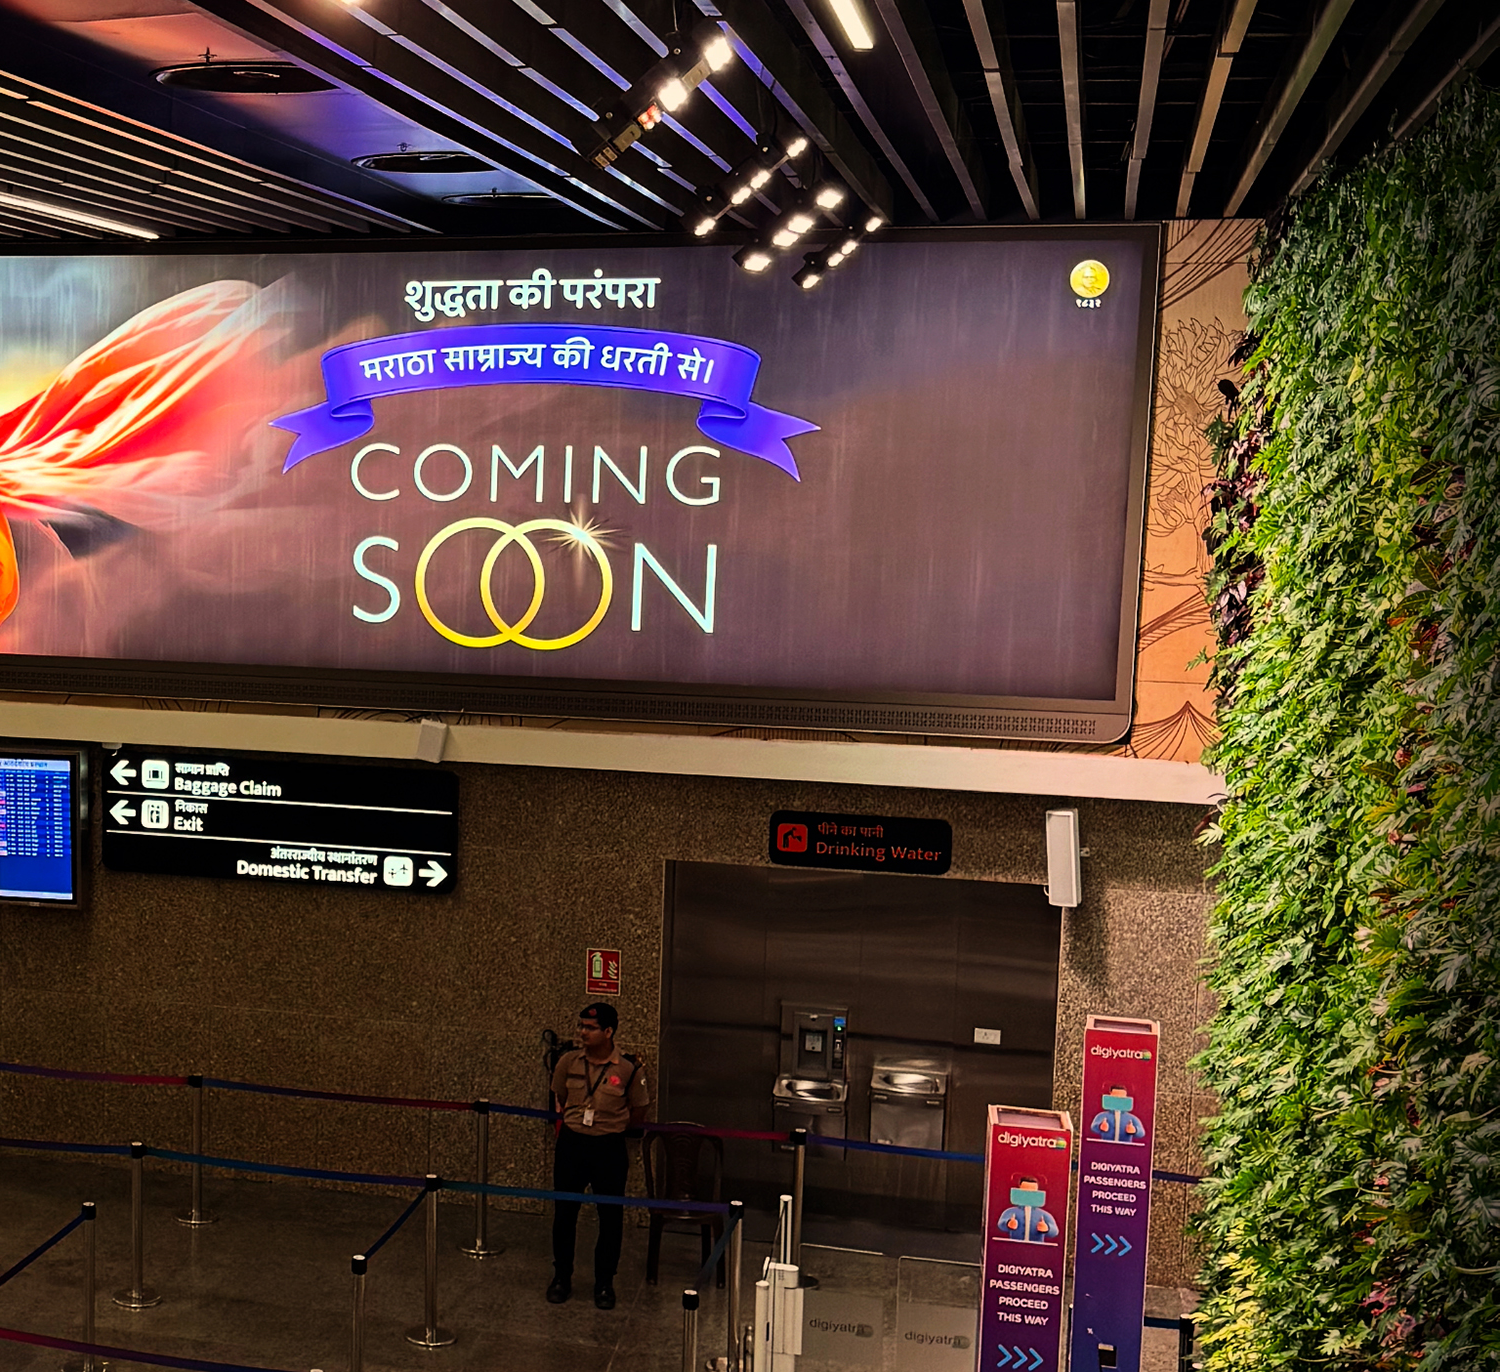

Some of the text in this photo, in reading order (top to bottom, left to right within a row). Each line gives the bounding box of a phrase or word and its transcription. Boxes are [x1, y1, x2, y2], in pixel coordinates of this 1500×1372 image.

[404, 267, 662, 322] शुद्धता की परंपरा
[359, 349, 437, 383] मराठा
[440, 343, 547, 372] साम्राज्य
[550, 336, 596, 370] की
[599, 342, 673, 376] धरती
[350, 442, 722, 507] COMING
[352, 516, 719, 651] SOON
[174, 776, 282, 797] Baggage Claim
[174, 799, 209, 814] निकास
[174, 816, 204, 832] Exit
[840, 825, 856, 837] का
[860, 825, 884, 838] पानी
[816, 842, 942, 862] Drinking Water
[237, 859, 378, 884] Domestic Transfer
[1090, 1044, 1144, 1060] digiyatra
[997, 1131, 1057, 1148] digiyatra
[1091, 1161, 1141, 1175] DIGIYATRA
[1083, 1175, 1147, 1190] PASSENGERS
[1092, 1190, 1137, 1203] PROCEED
[1090, 1204, 1137, 1217] THIS WAY
[998, 1264, 1054, 1279] DIGIYATRA
[989, 1279, 1061, 1296] PASSENGERS
[998, 1296, 1049, 1310] PROCEED
[809, 1318, 865, 1334] digiyatra
[997, 1311, 1049, 1326] THIS WAY
[904, 1331, 961, 1348] digiyatra
